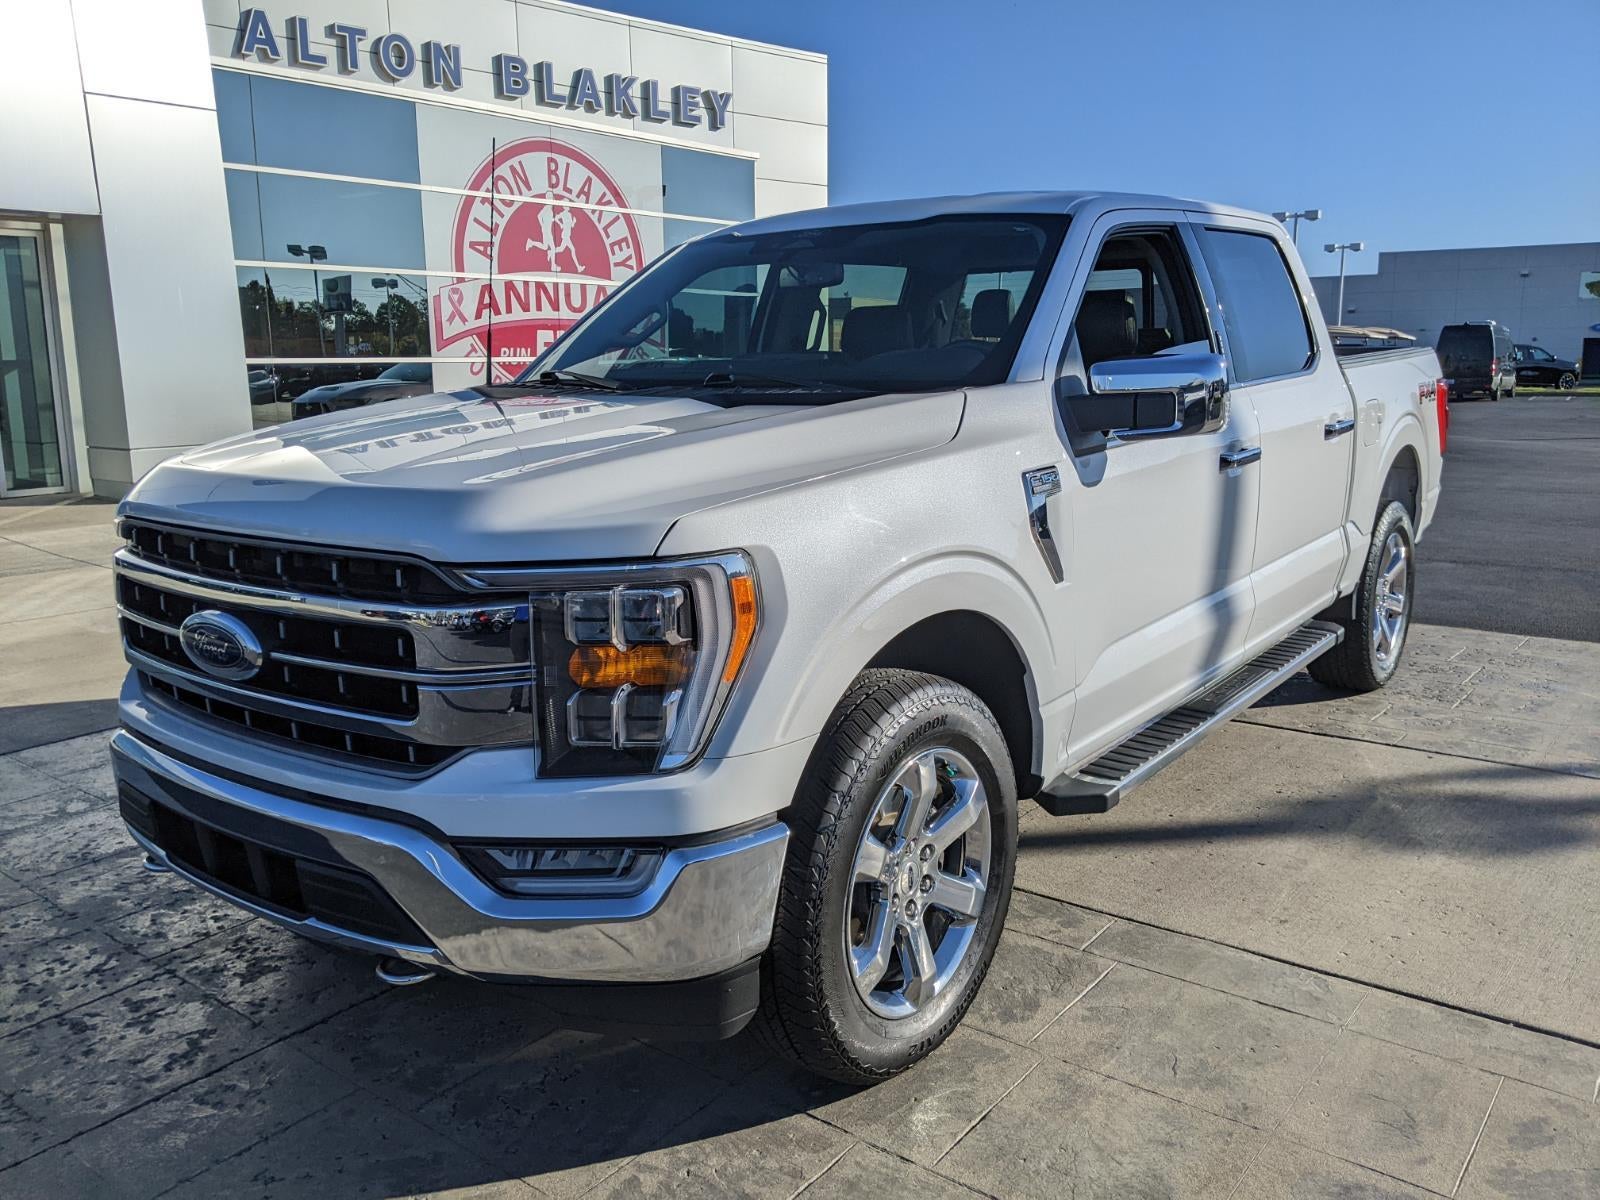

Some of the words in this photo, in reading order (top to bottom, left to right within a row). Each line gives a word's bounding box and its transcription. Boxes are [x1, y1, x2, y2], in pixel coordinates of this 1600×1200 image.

[236, 8, 463, 91] ALTON
[492, 53, 732, 131] BLAKLEY
[468, 160, 533, 260] ALTON
[546, 157, 635, 271] BLAKLEY
[474, 280, 609, 321] ANNUA
[500, 346, 531, 365] RUN
